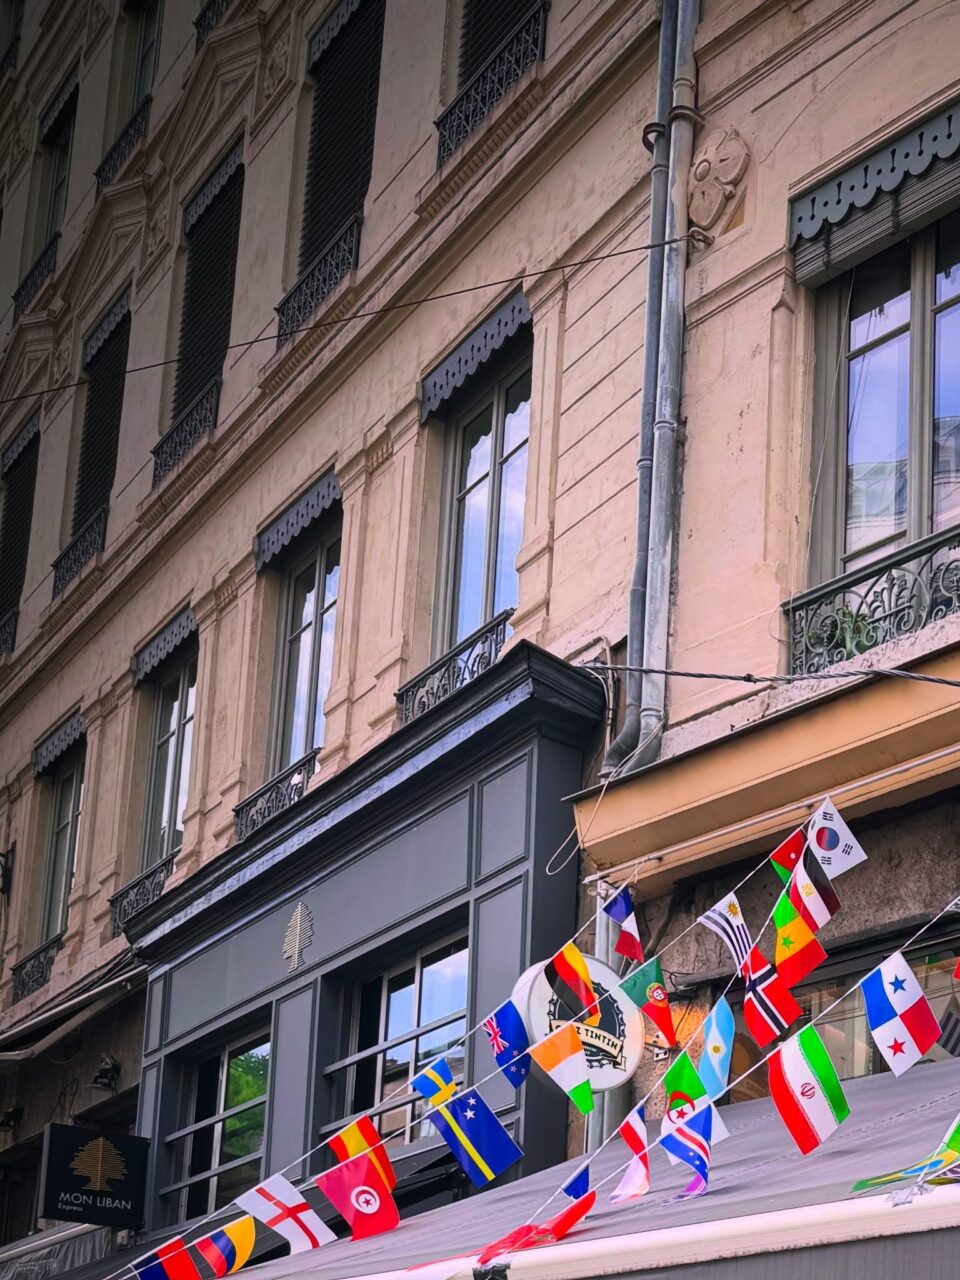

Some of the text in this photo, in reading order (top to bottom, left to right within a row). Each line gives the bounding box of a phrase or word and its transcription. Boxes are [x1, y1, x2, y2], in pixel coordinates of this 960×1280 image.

[584, 1028, 618, 1050] TINTIN
[58, 1202, 83, 1212] Express
[59, 1192, 132, 1210] MON LIBAN
